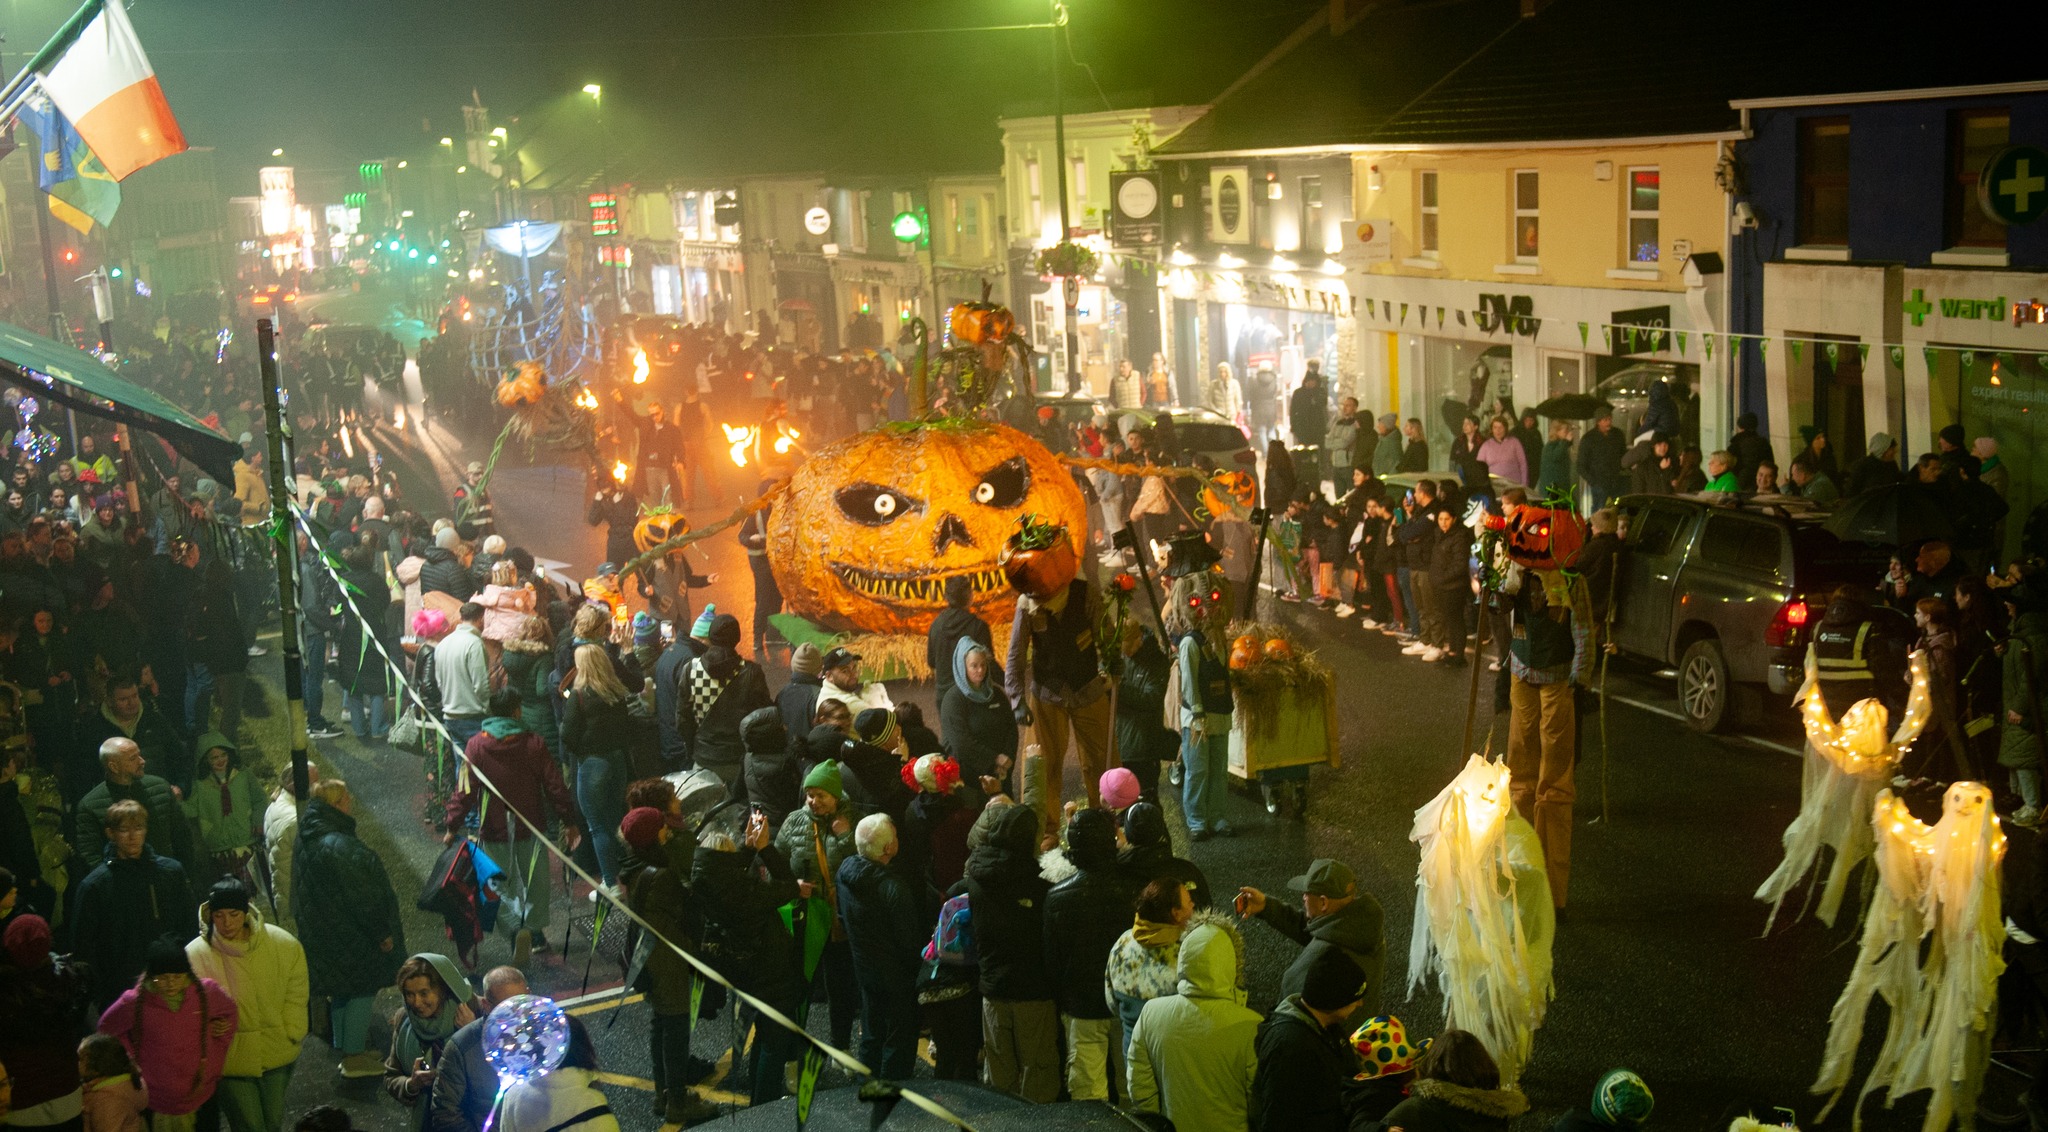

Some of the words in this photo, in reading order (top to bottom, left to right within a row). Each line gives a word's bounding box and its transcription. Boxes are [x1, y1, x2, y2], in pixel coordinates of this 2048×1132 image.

[1067, 278, 1075, 302] P
[1479, 293, 1534, 336] DV8
[1940, 296, 2006, 321] ward
[2012, 298, 2048, 328] ph
[1620, 318, 1664, 344] DV8
[1971, 386, 2010, 400] expert
